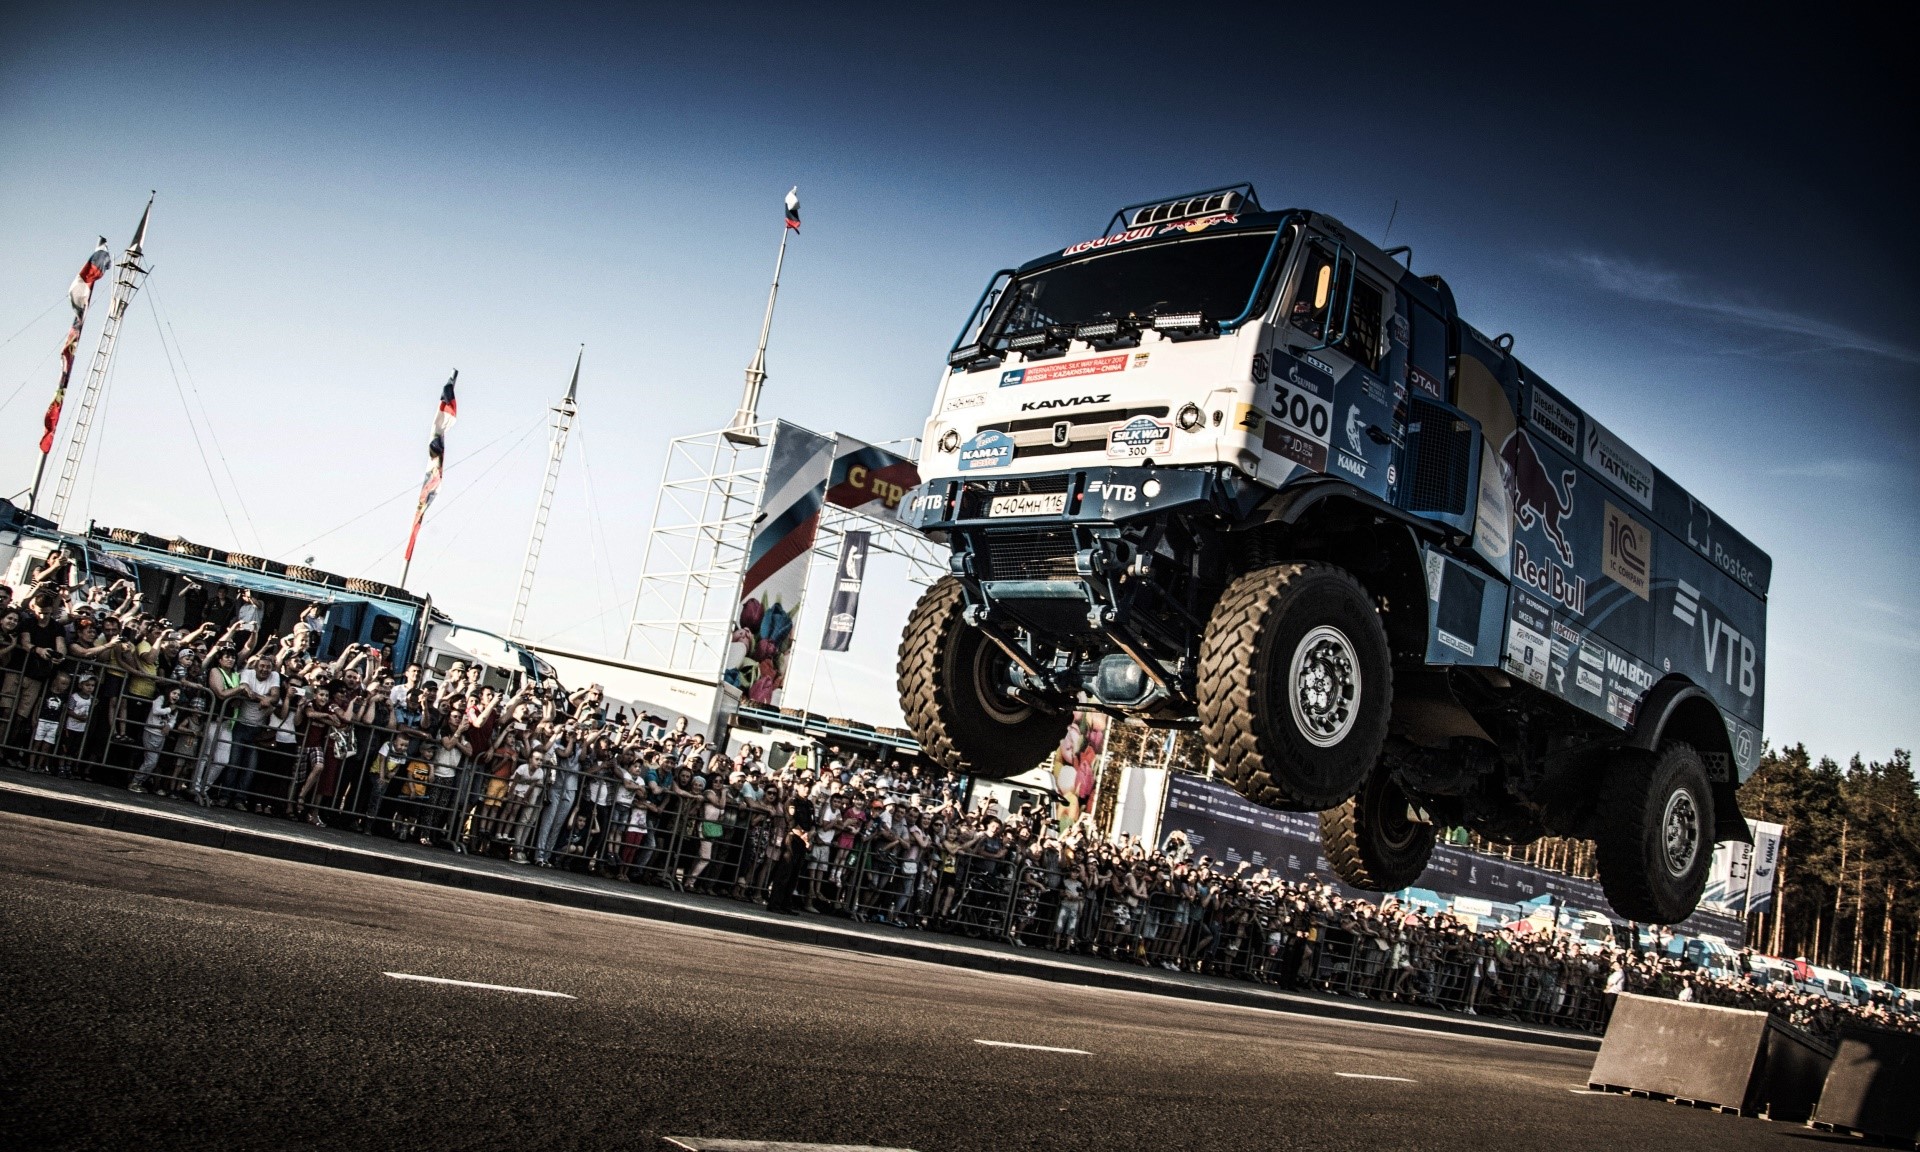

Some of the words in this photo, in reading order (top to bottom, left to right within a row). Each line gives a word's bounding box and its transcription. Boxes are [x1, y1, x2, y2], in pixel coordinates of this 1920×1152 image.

[1025, 373, 1048, 383] RUSSIA
[1053, 368, 1095, 379] KAZAKHSTAN
[1101, 364, 1122, 373] CHINA
[1027, 363, 1067, 375] INTERNATIONAL
[1069, 361, 1081, 370] SILK
[1081, 359, 1093, 368] WAY
[1093, 357, 1111, 367] RALLY
[1021, 394, 1111, 412] KAMAZ
[1271, 383, 1329, 438] 300
[1534, 390, 1576, 430] Diesel-Power
[1113, 429, 1141, 441] SILK
[1141, 428, 1168, 440] WAY
[1533, 408, 1574, 449] LIEBHERR
[962, 446, 1008, 461] KAMAZ
[1128, 446, 1147, 457] 300
[1291, 437, 1302, 453] JD
[969, 457, 999, 468] master
[1337, 453, 1367, 479] KAMAZ
[1599, 450, 1649, 499] TATNEFT
[849, 466, 867, 488] С
[871, 478, 911, 507] пр
[1101, 483, 1137, 502] VTB
[1044, 495, 1063, 508] 116
[1715, 542, 1753, 587] Rostec
[1514, 540, 1551, 596] Red
[1550, 562, 1585, 616] Bull
[1618, 566, 1645, 589] COMPANY
[1439, 631, 1473, 655] ICEQUEEN
[1554, 620, 1579, 644] LOCTITE
[1701, 607, 1756, 698] VTB
[1607, 650, 1653, 690] WABCO
[1738, 735, 1751, 760] ZF
[1766, 838, 1777, 864] KAMAZ
